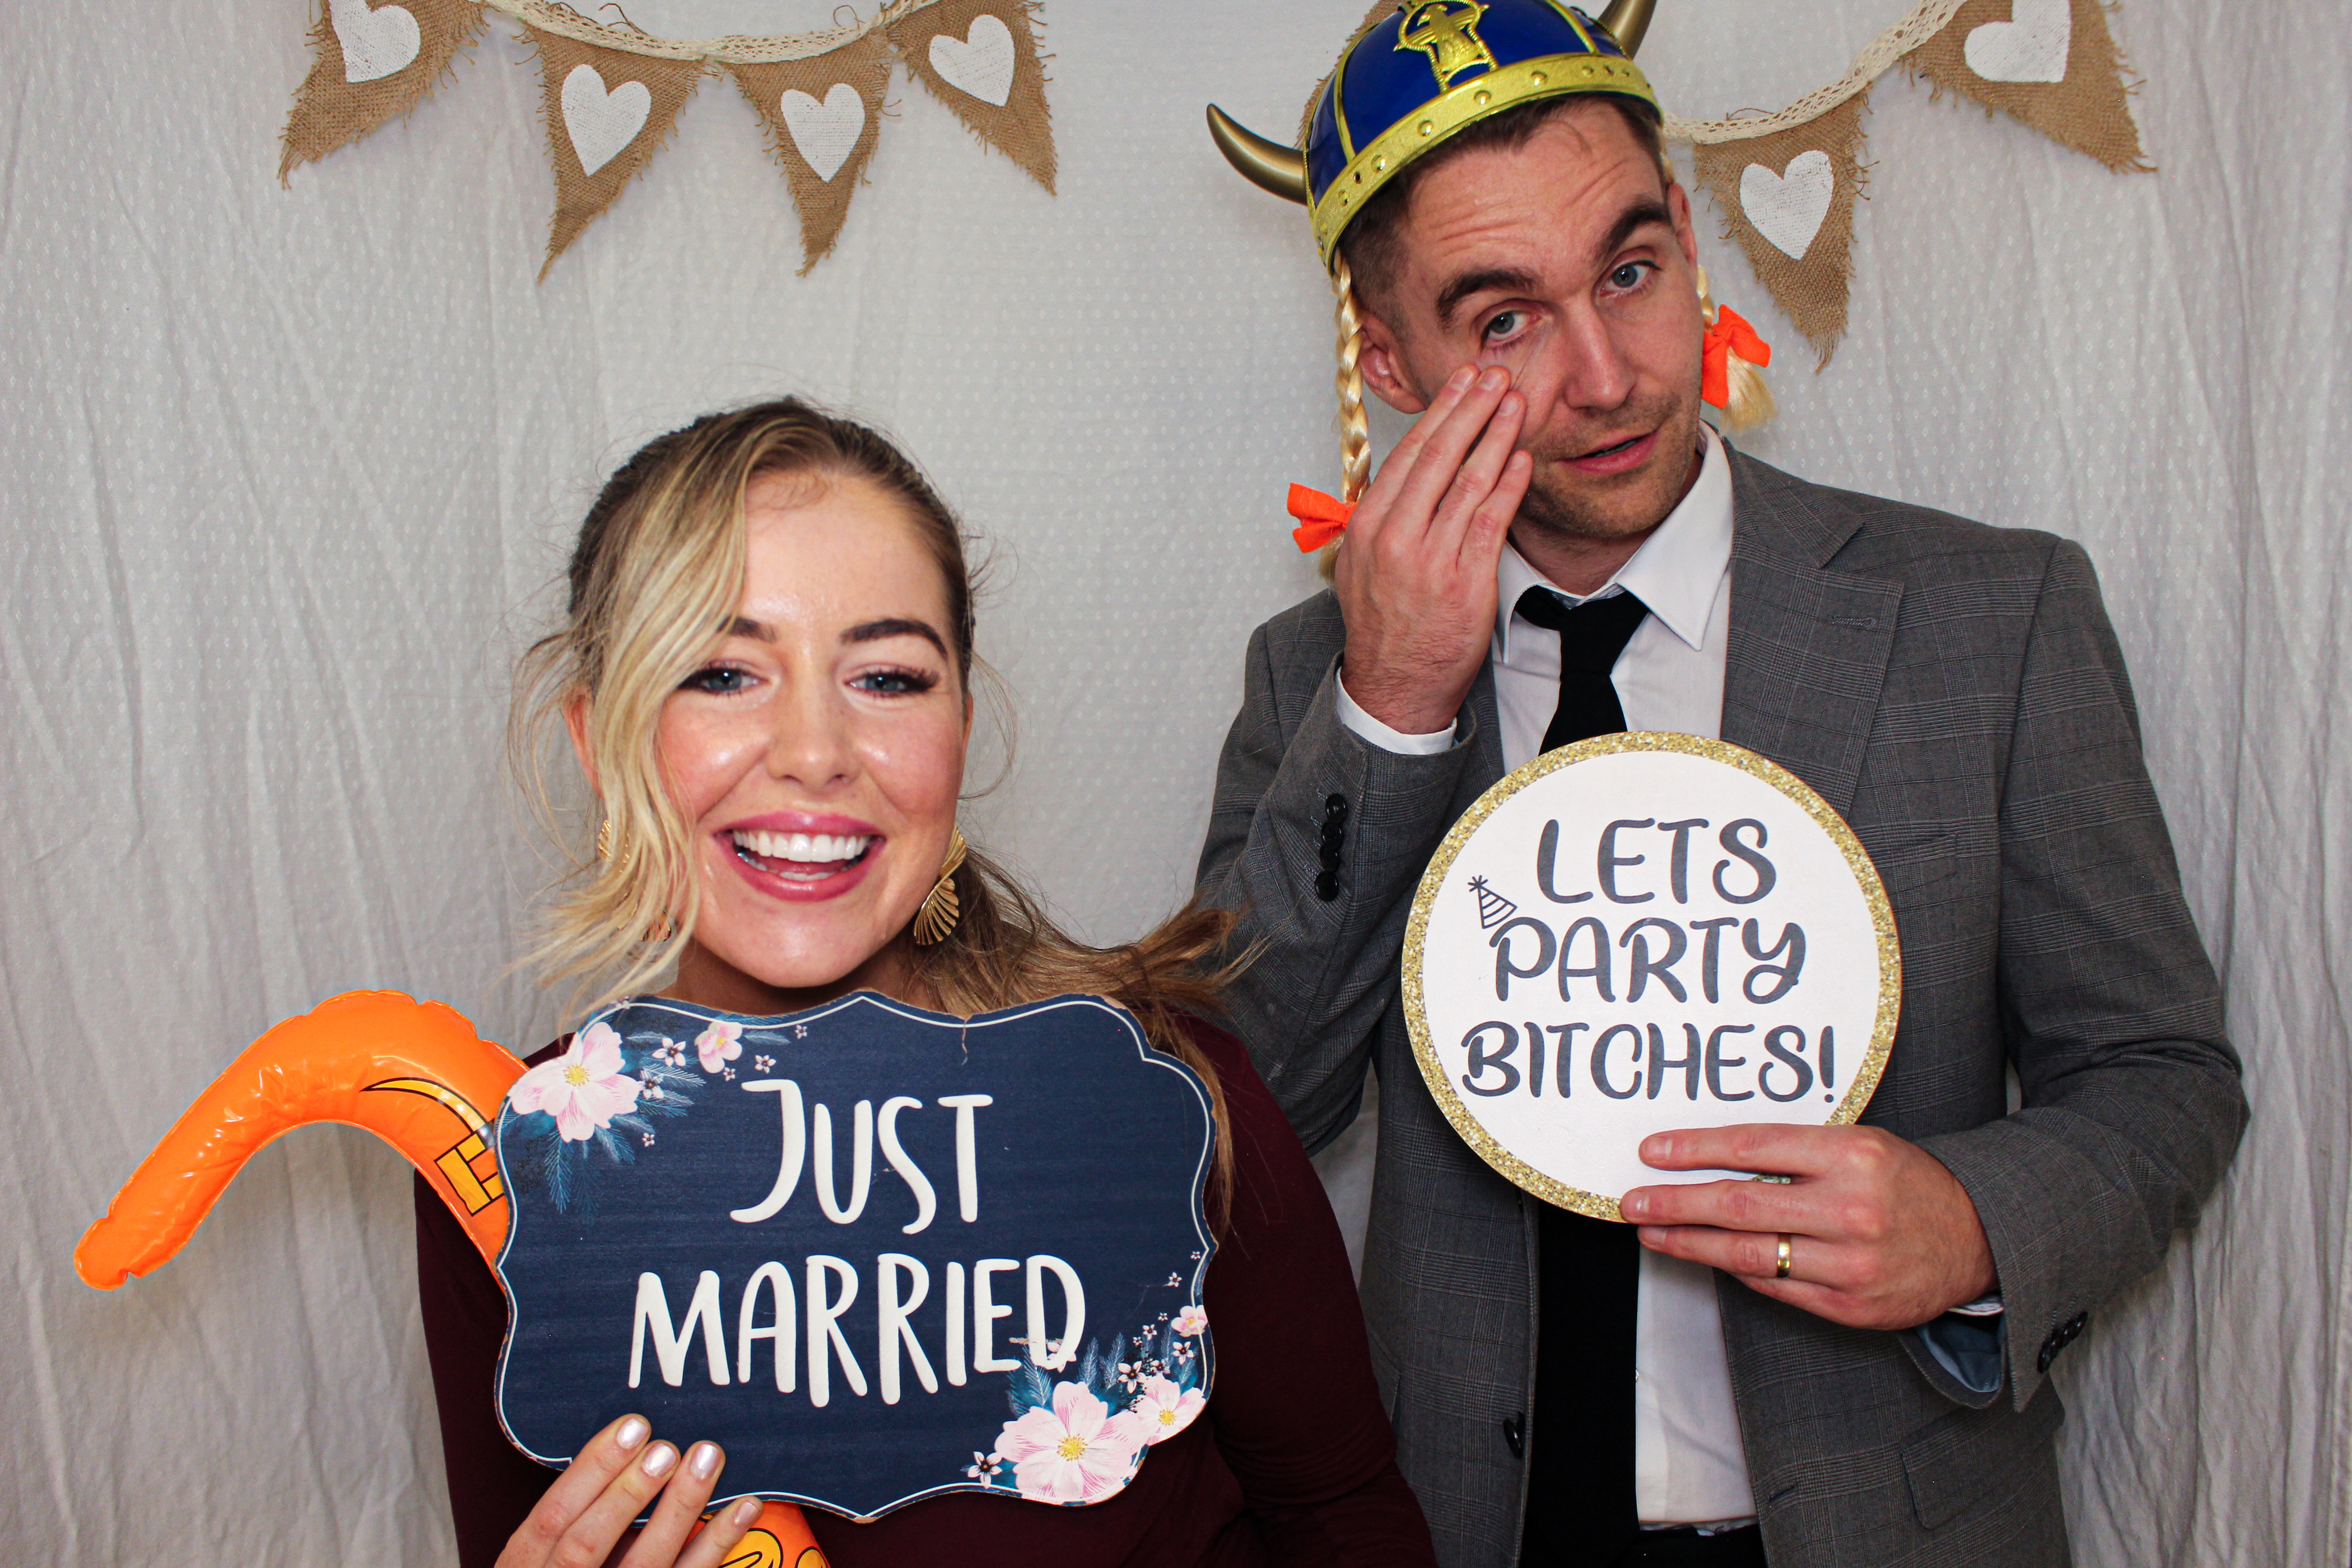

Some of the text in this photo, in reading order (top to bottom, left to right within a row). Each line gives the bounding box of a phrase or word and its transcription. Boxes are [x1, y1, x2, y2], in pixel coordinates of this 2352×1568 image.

[1537, 818, 1776, 904] LETS
[1490, 917, 1806, 1004] PARTY
[1461, 1021, 1834, 1103] BITCHES!
[730, 1079, 993, 1234] JUST
[628, 1254, 1086, 1408] MARRIED
